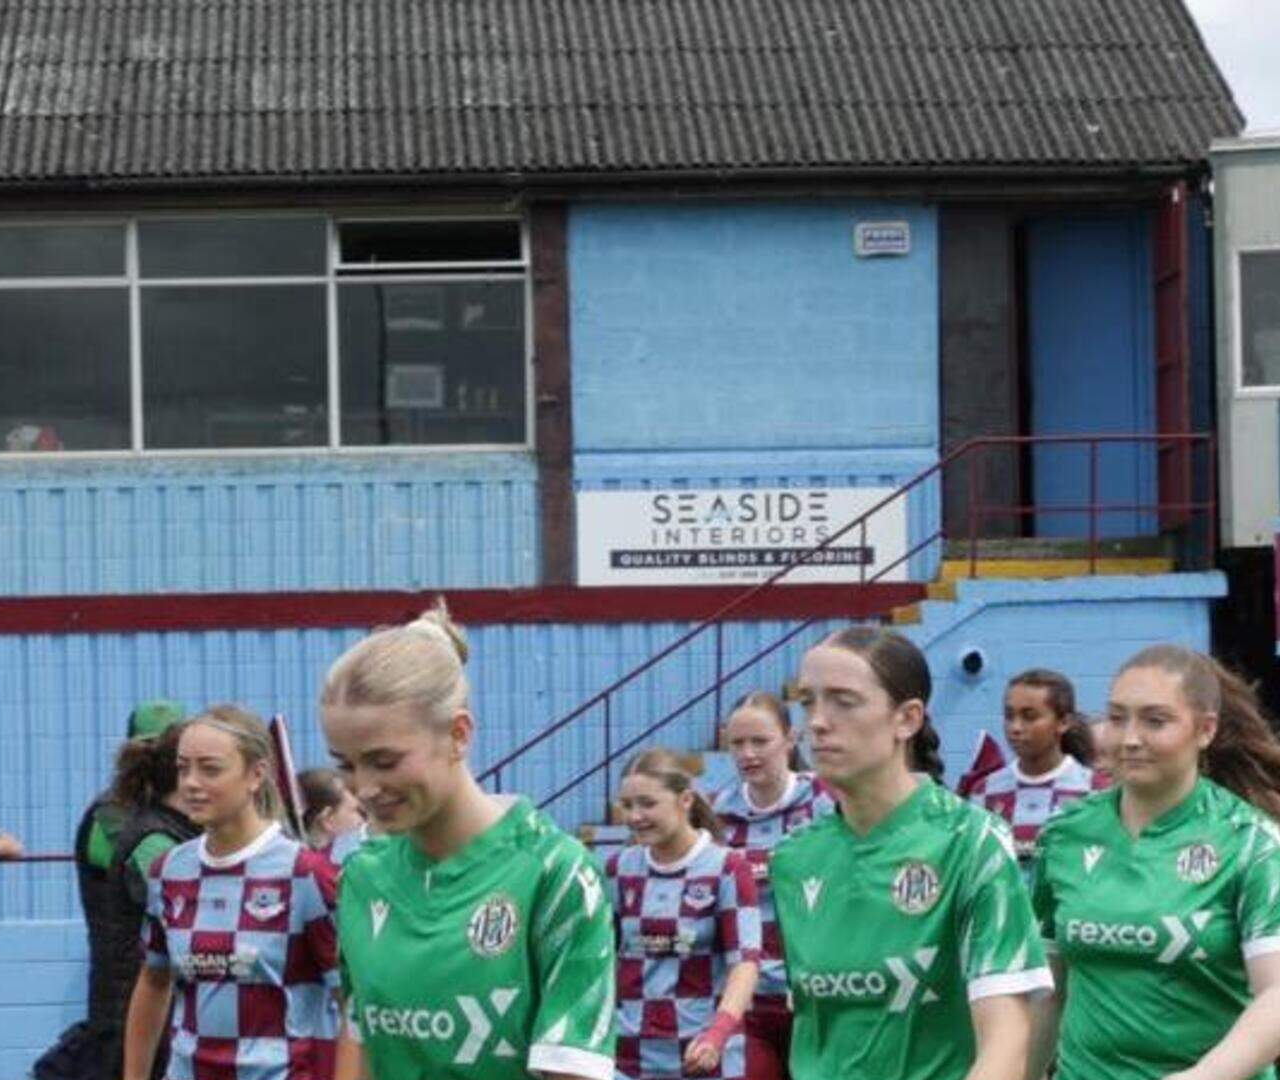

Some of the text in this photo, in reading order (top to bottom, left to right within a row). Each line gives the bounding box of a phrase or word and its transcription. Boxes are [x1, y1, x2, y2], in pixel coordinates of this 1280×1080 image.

[652, 492, 828, 525] SEASIDE
[651, 525, 830, 547] INTERIORS
[620, 552, 694, 566] QUALITY
[697, 551, 759, 565] BLINDS
